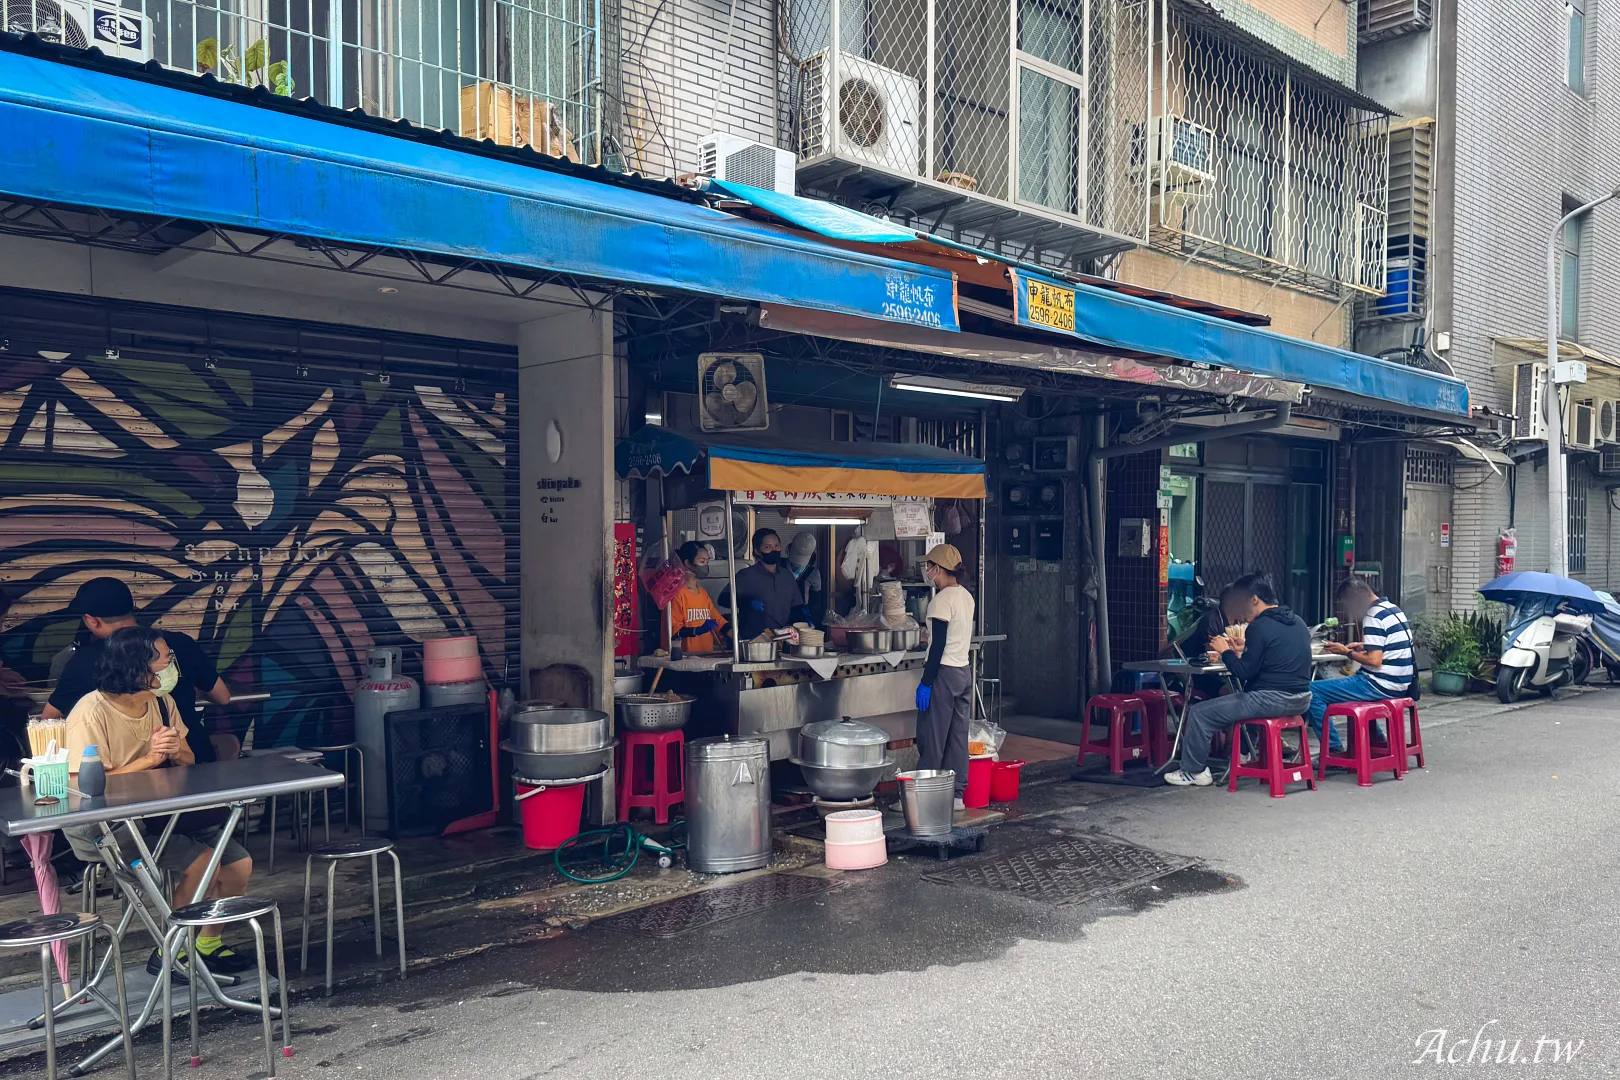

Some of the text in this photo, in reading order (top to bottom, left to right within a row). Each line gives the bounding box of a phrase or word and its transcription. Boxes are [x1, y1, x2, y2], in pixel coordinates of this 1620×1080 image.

[1029, 282, 1074, 312] 申龍帆布
[214, 600, 240, 611] br
